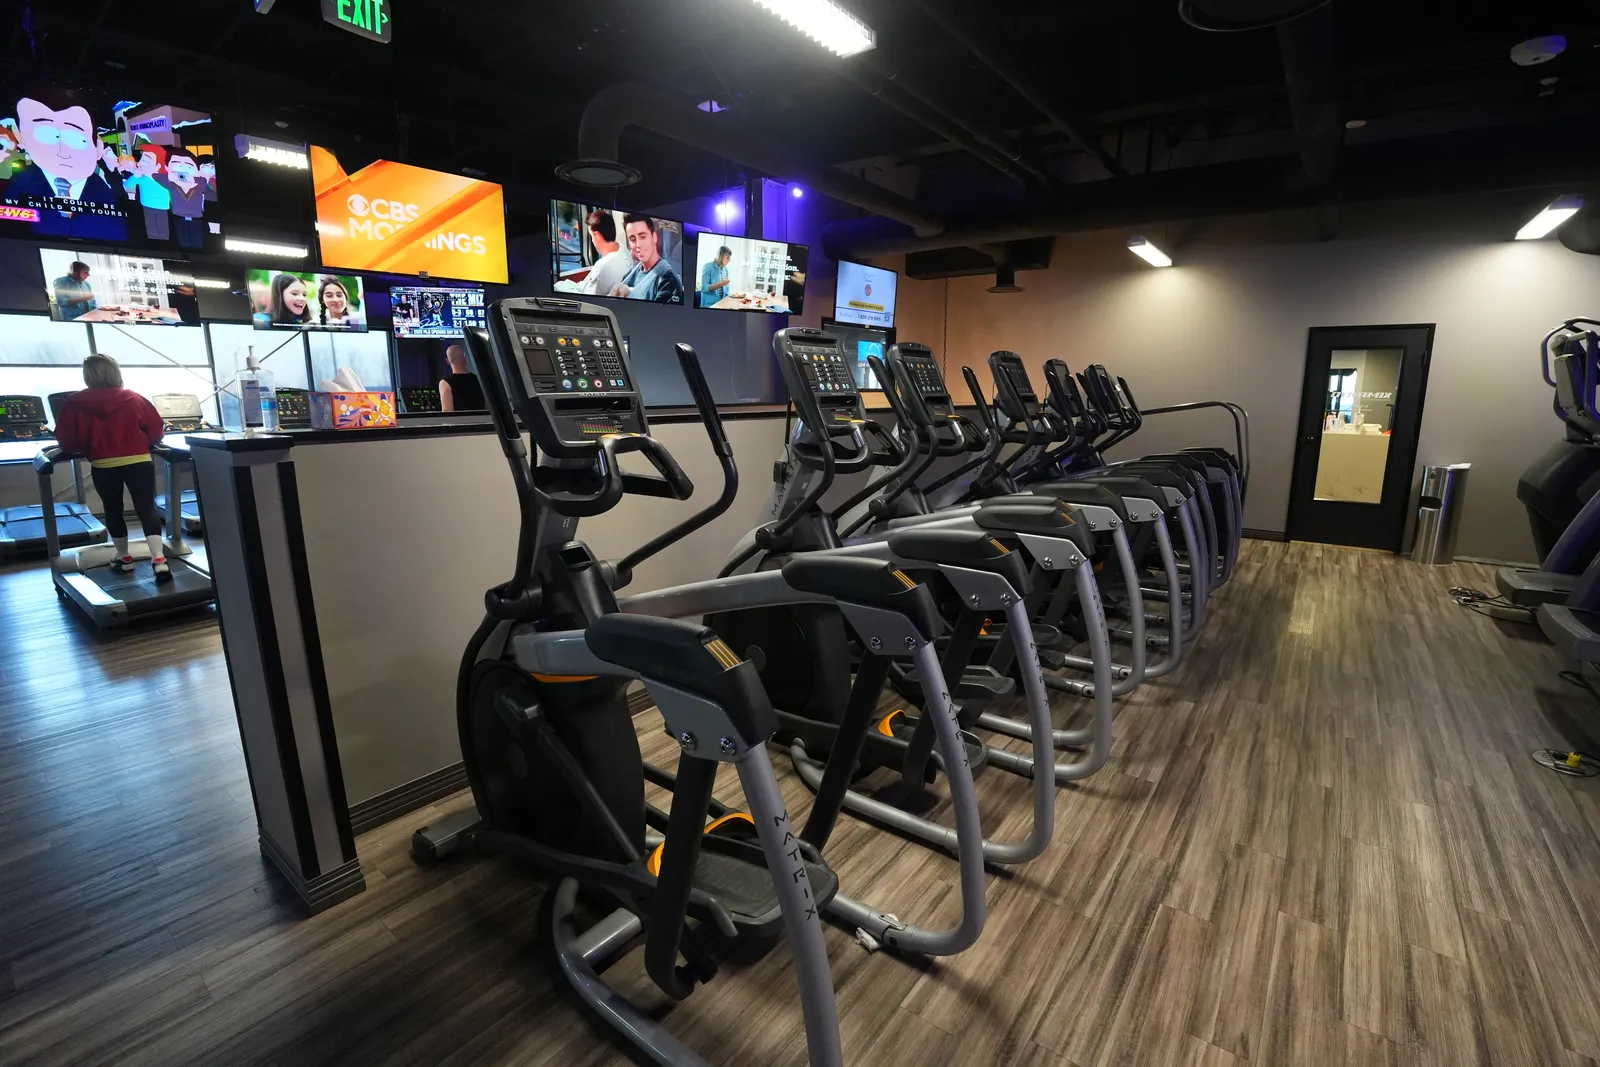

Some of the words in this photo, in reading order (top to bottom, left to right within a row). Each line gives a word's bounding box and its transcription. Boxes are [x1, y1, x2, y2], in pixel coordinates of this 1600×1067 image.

[337, 0, 383, 35] EXIT
[28, 201, 63, 210] CHILD
[63, 198, 96, 207] COULD
[370, 198, 420, 223] CBS
[349, 217, 486, 255] MOINGS
[773, 809, 817, 921] MATRIX
